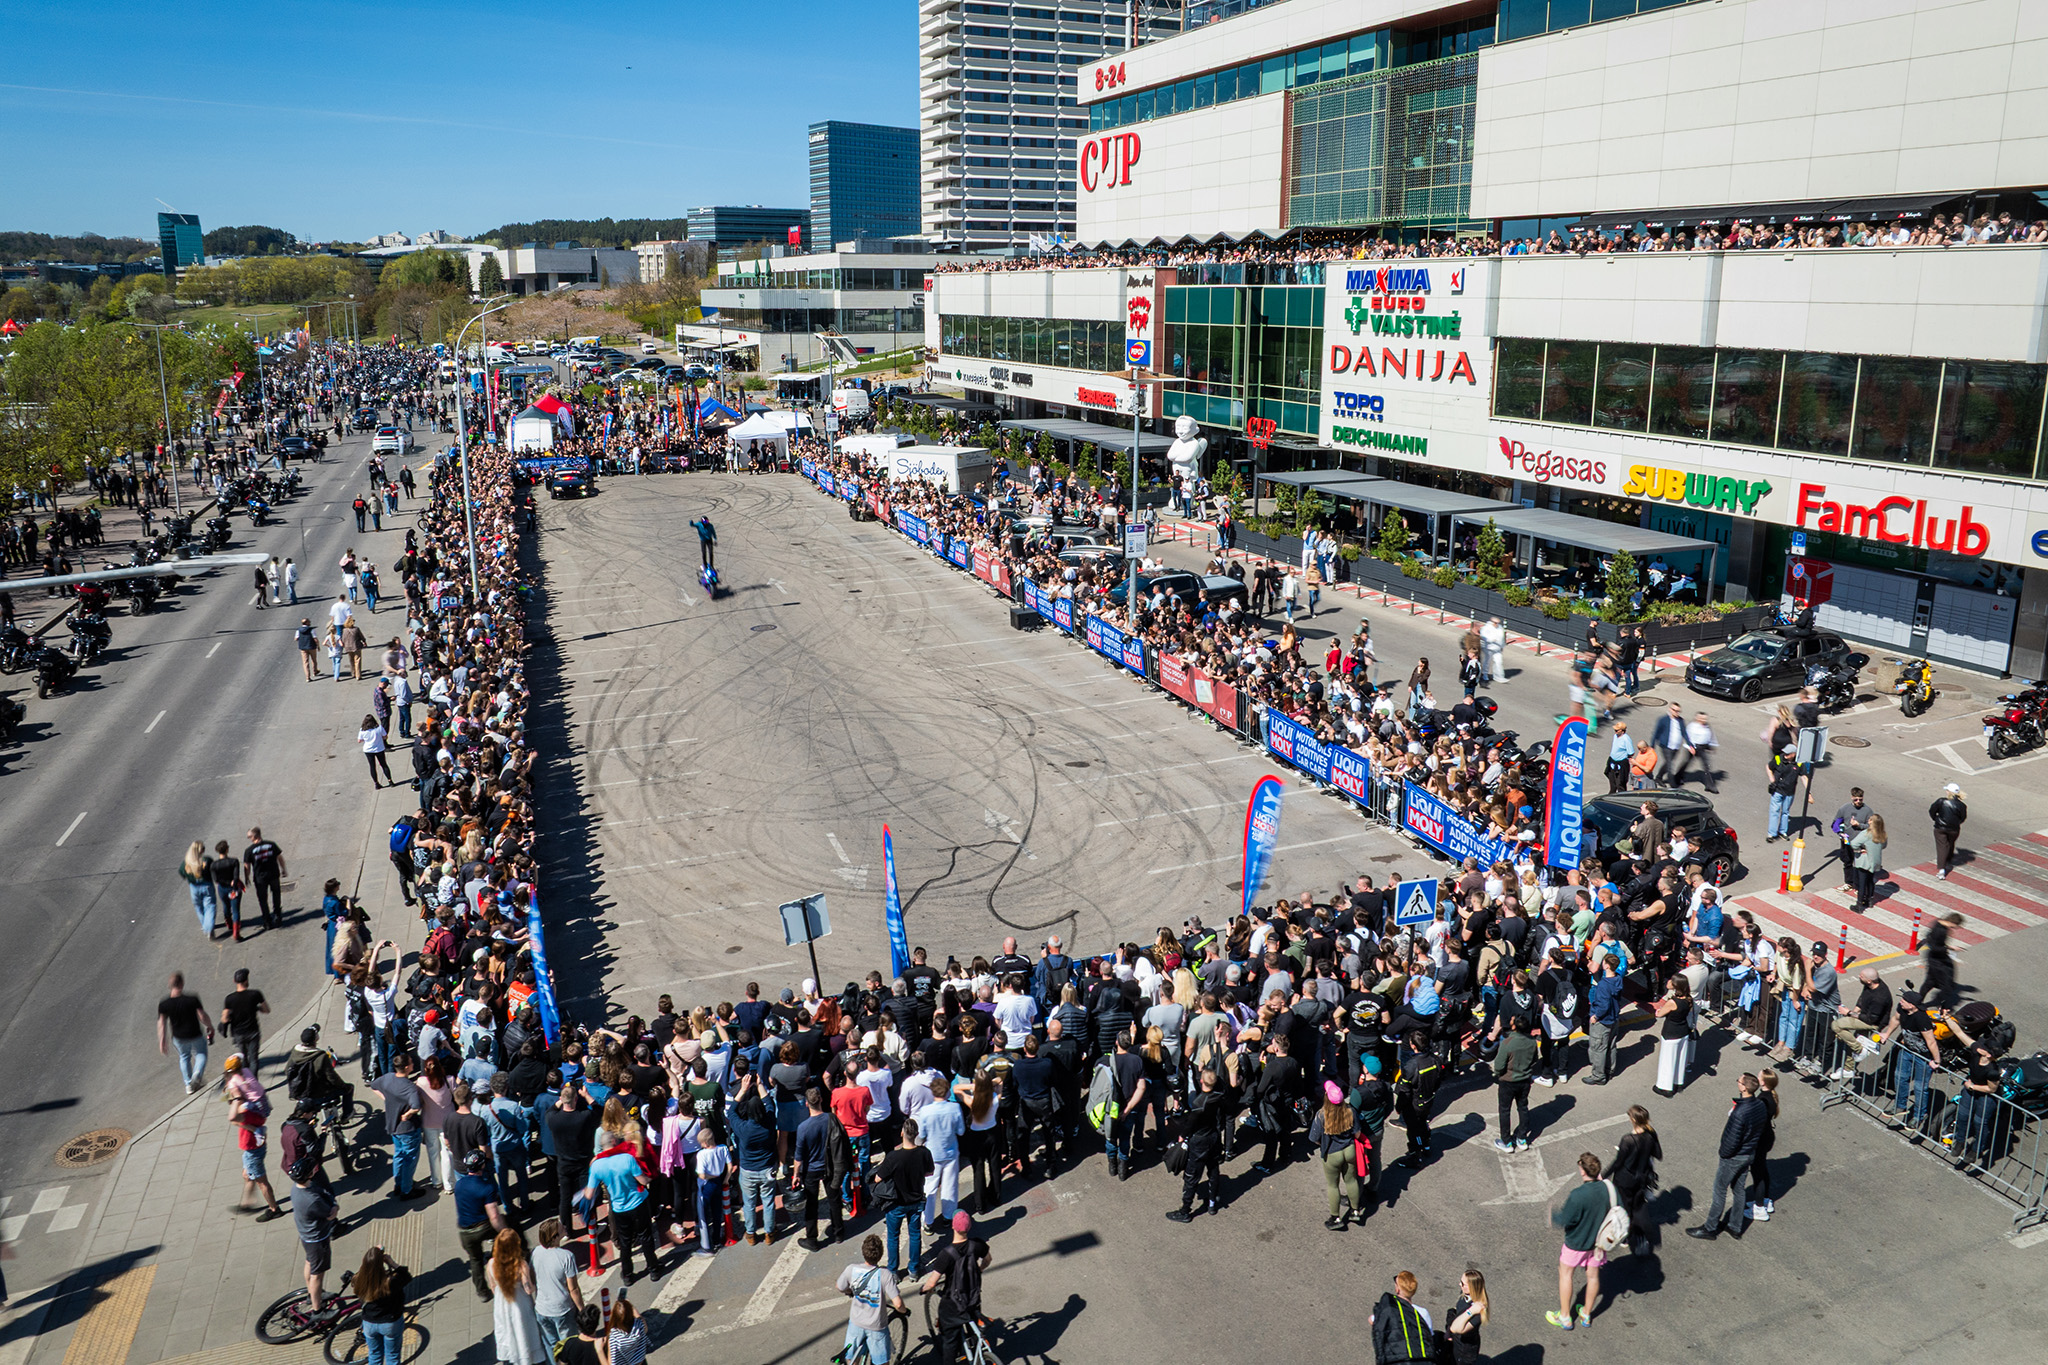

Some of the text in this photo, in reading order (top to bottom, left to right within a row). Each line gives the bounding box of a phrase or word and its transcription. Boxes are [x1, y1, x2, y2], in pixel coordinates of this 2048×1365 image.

[1095, 61, 1126, 91] 8-24
[1080, 132, 1141, 192] CUP
[1345, 266, 1431, 295] MAXIMA
[1371, 297, 1425, 312] EURO
[1370, 310, 1462, 338] VAISTINĖ
[1130, 347, 1144, 356] PEPCO
[1330, 345, 1476, 384] DANIJA
[1333, 391, 1384, 412] TOPO
[1333, 409, 1383, 422] CENTRAS
[1246, 417, 1277, 439] CUP
[1332, 425, 1428, 455] DEICHMANN
[896, 458, 946, 476] Sjöboden
[1510, 440, 1607, 483] Pegasas
[1622, 464, 1772, 513] SUBWAY
[1796, 483, 1990, 556] FamClub
[1715, 528, 1732, 545] LI
[1796, 534, 1803, 542] P
[440, 597, 449, 608] P
[1055, 610, 1070, 627] MOLY
[1087, 618, 1102, 636] LIQUI
[1088, 629, 1101, 648] MOLY
[1123, 639, 1140, 656] LQUI
[1123, 650, 1142, 669] MOLY
[1271, 717, 1294, 740] LIQUI
[1270, 732, 1293, 756] MOLY
[1295, 731, 1317, 750] MOTOR
[1295, 743, 1328, 768] ADDITIVES
[1296, 754, 1327, 778] CAR CARE
[1334, 752, 1363, 779] LIQUI
[1559, 753, 1579, 768] LIQUI
[1557, 761, 1579, 777] MOLY
[1332, 767, 1363, 795] MOLY
[1410, 790, 1442, 823] LIQUI
[1253, 818, 1276, 835] MOLY
[1255, 811, 1276, 826] LIQUI
[1409, 807, 1443, 840] MOLY
[1446, 814, 1475, 837] MOTOR
[1449, 826, 1491, 861] ADDITIVES
[1559, 803, 1582, 868] LIQUI
[1450, 839, 1467, 857] CAR
